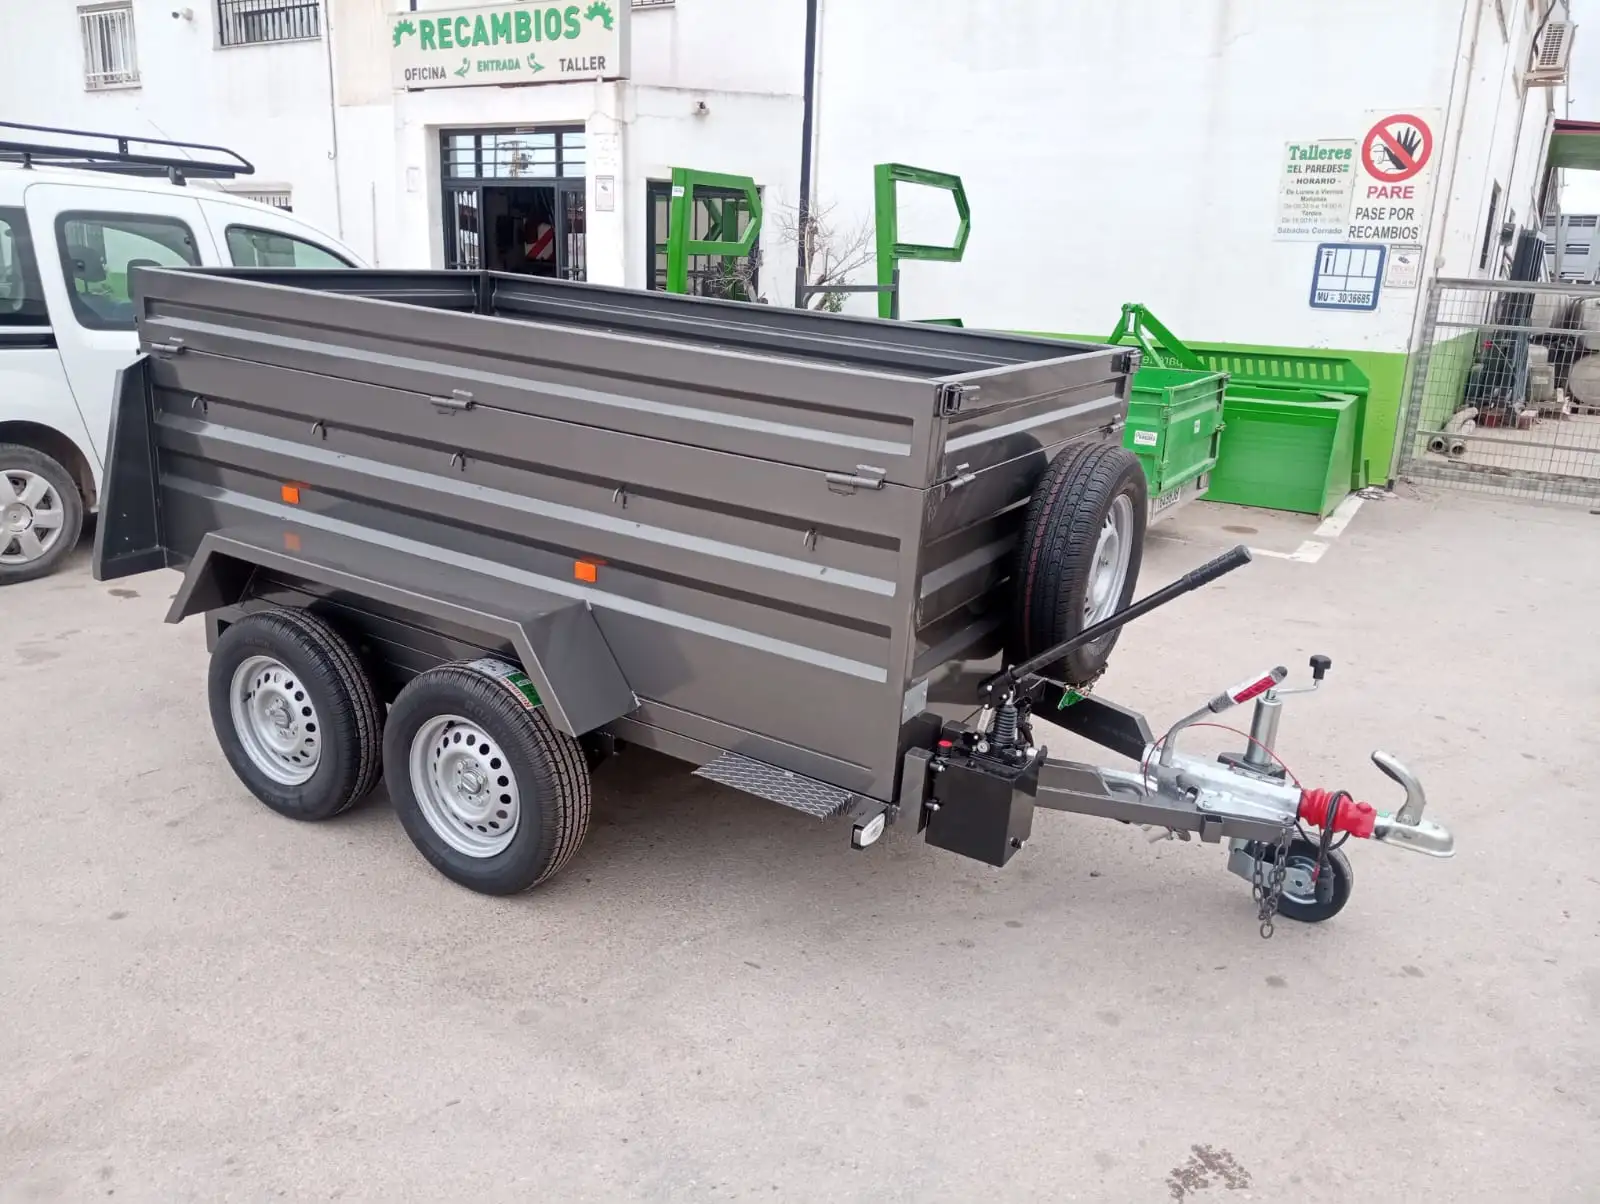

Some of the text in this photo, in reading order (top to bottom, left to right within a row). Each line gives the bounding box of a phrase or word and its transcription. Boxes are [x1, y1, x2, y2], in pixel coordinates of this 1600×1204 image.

[419, 5, 581, 51] RECAMBIOS
[477, 58, 521, 73] ENTRADA
[559, 55, 606, 73] TALLER
[404, 65, 447, 81] OFICINA
[1289, 145, 1352, 160] Talleres
[1293, 164, 1343, 173] EL PAREDES
[1366, 186, 1415, 199] PARE
[1355, 207, 1386, 220] PASE
[1388, 207, 1414, 220] POR
[1348, 226, 1419, 239] RECAMBIOS
[1317, 291, 1329, 301] MU
